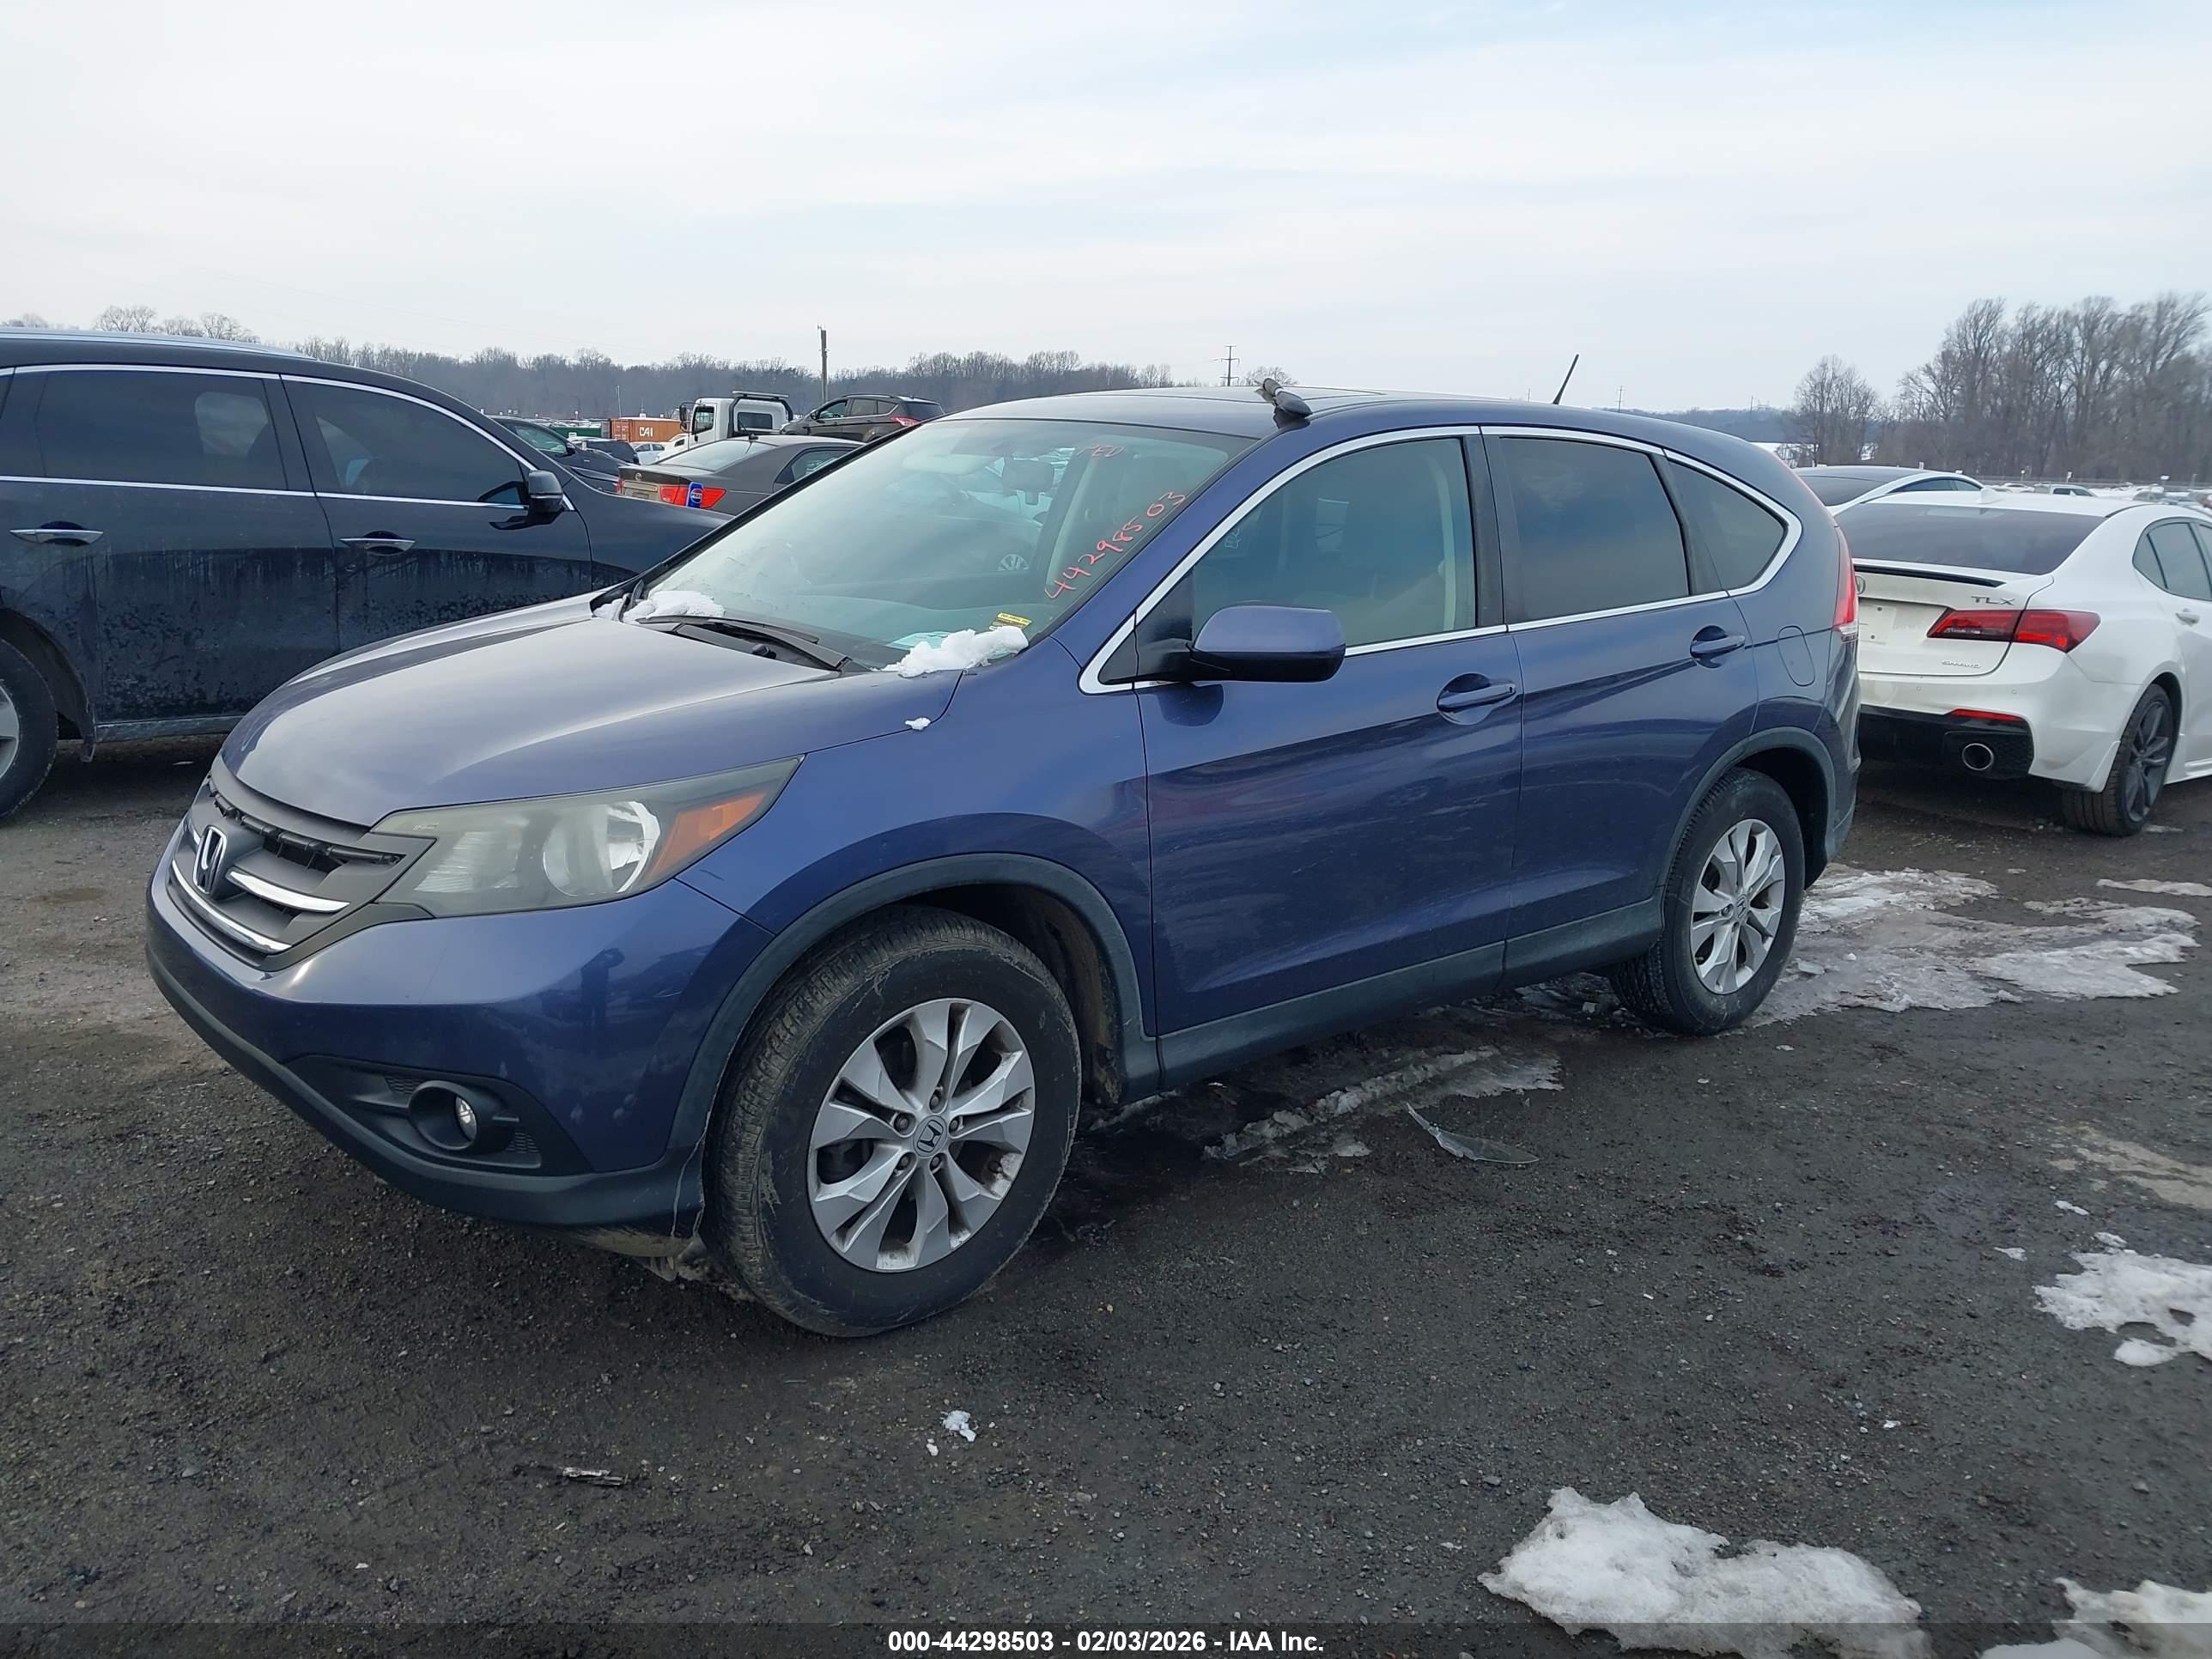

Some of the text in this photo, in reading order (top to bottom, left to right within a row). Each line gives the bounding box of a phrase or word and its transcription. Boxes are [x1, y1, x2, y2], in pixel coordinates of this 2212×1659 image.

[639, 427, 653, 436] CAI
[1044, 491, 1186, 599] 44298503
[1971, 596, 2014, 606] TLX
